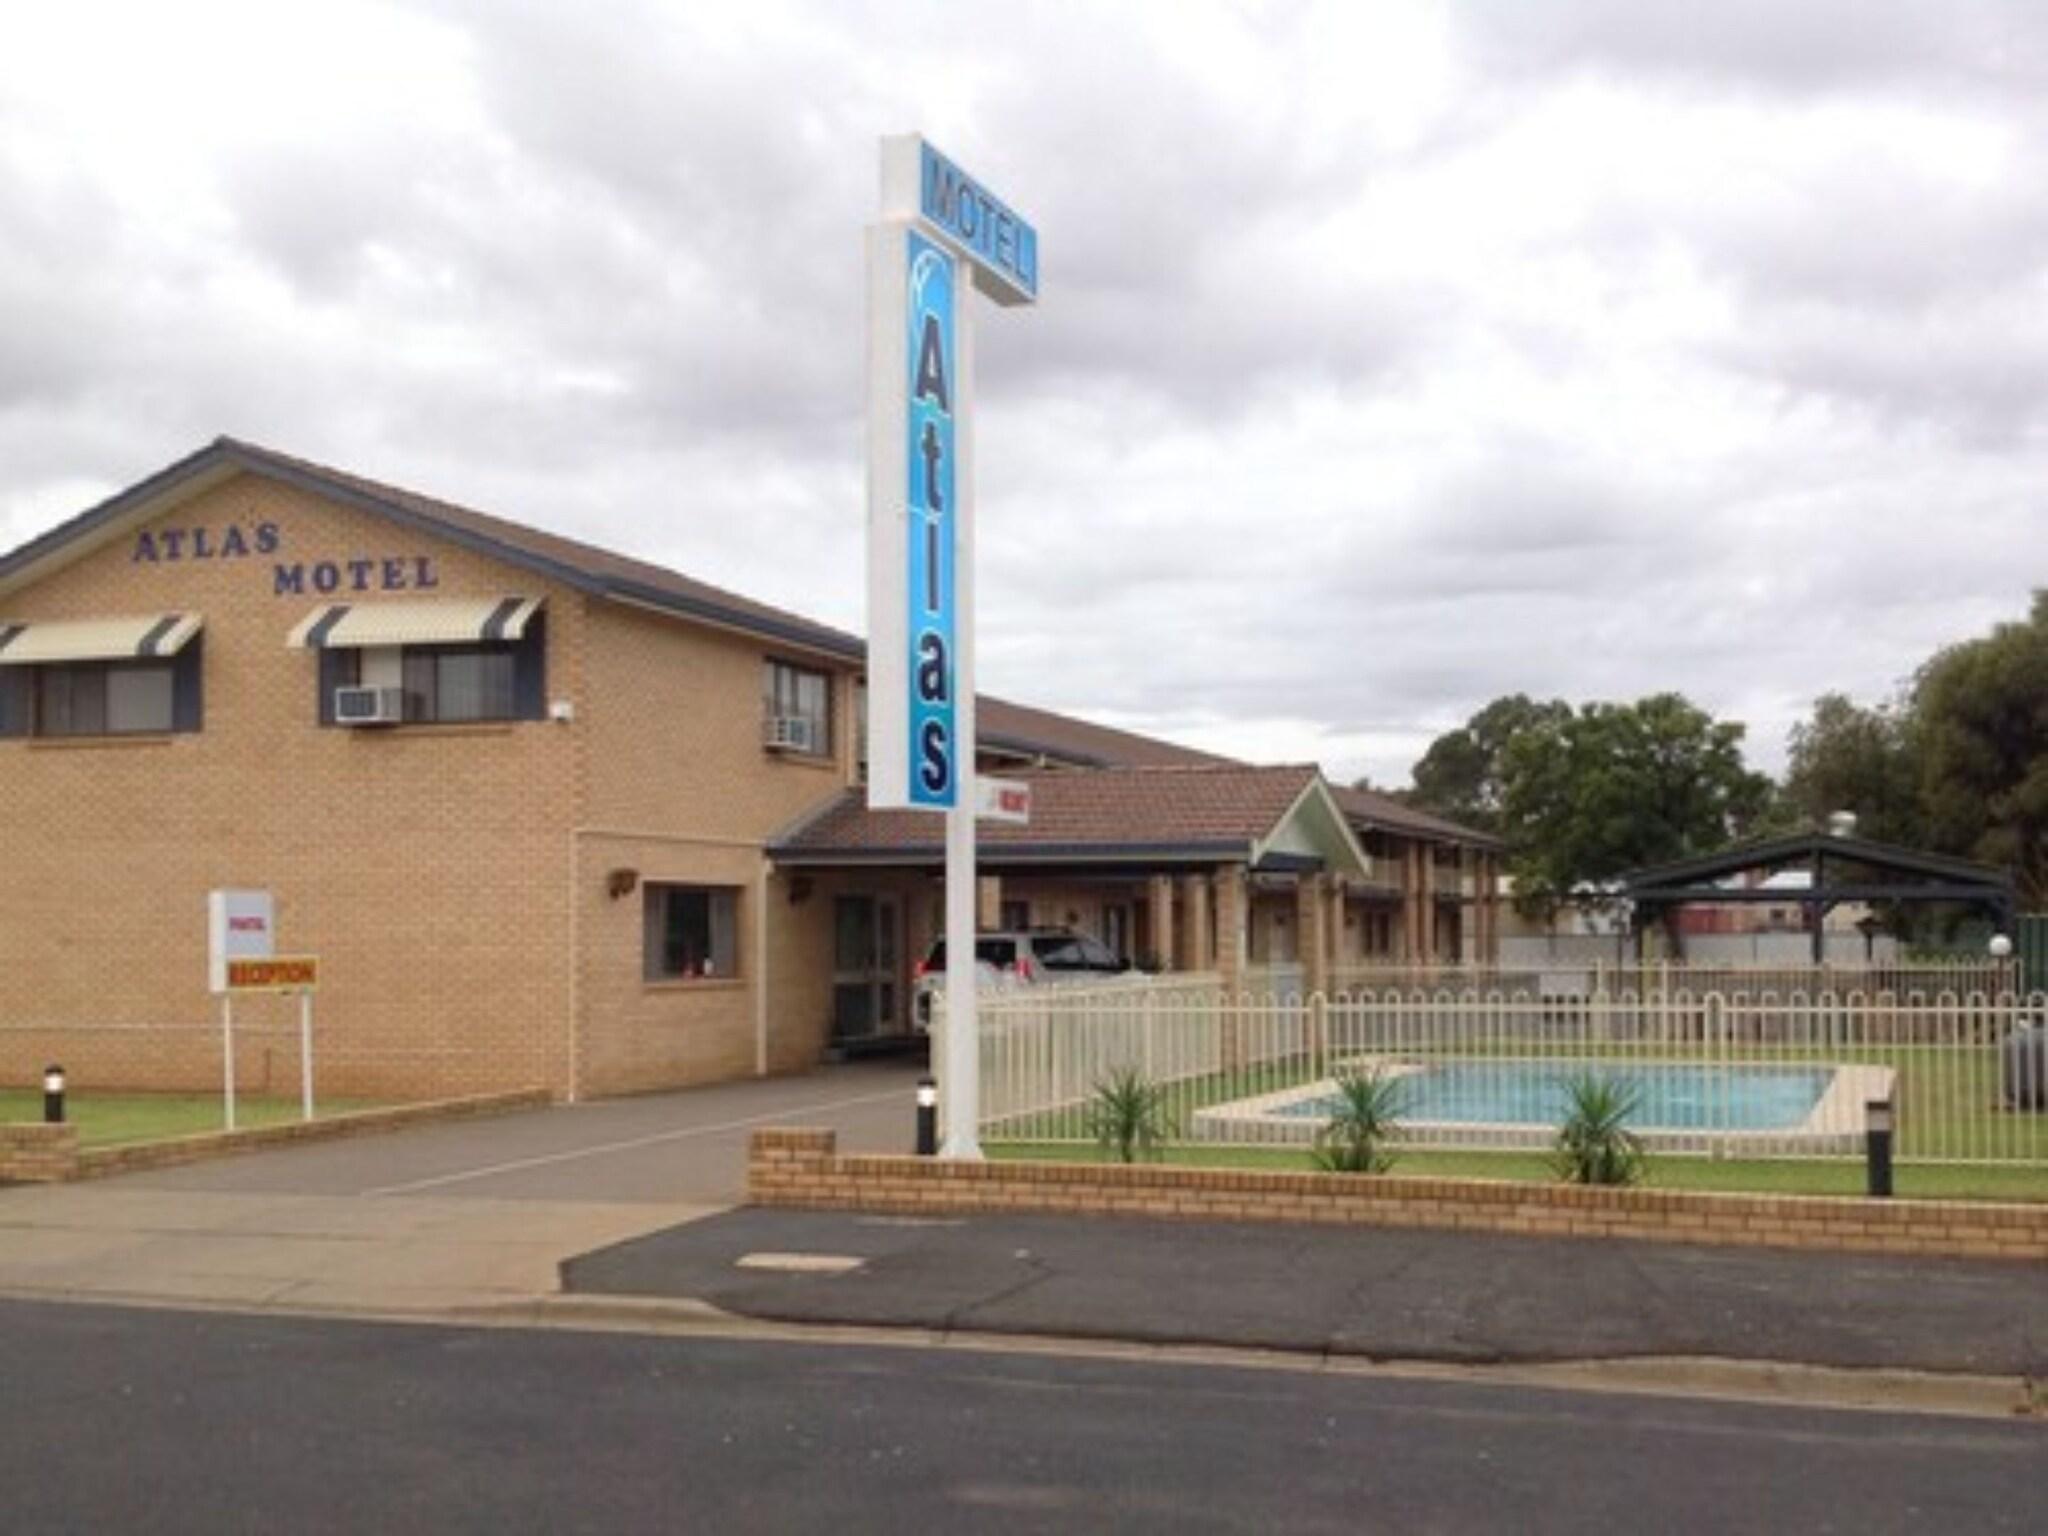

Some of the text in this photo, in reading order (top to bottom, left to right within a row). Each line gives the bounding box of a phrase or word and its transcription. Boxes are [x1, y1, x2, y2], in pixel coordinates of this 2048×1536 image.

[929, 157, 1031, 282] MOTEL
[132, 523, 280, 562] ATLAS
[273, 556, 439, 595] MOTEL
[915, 313, 949, 793] Atlas
